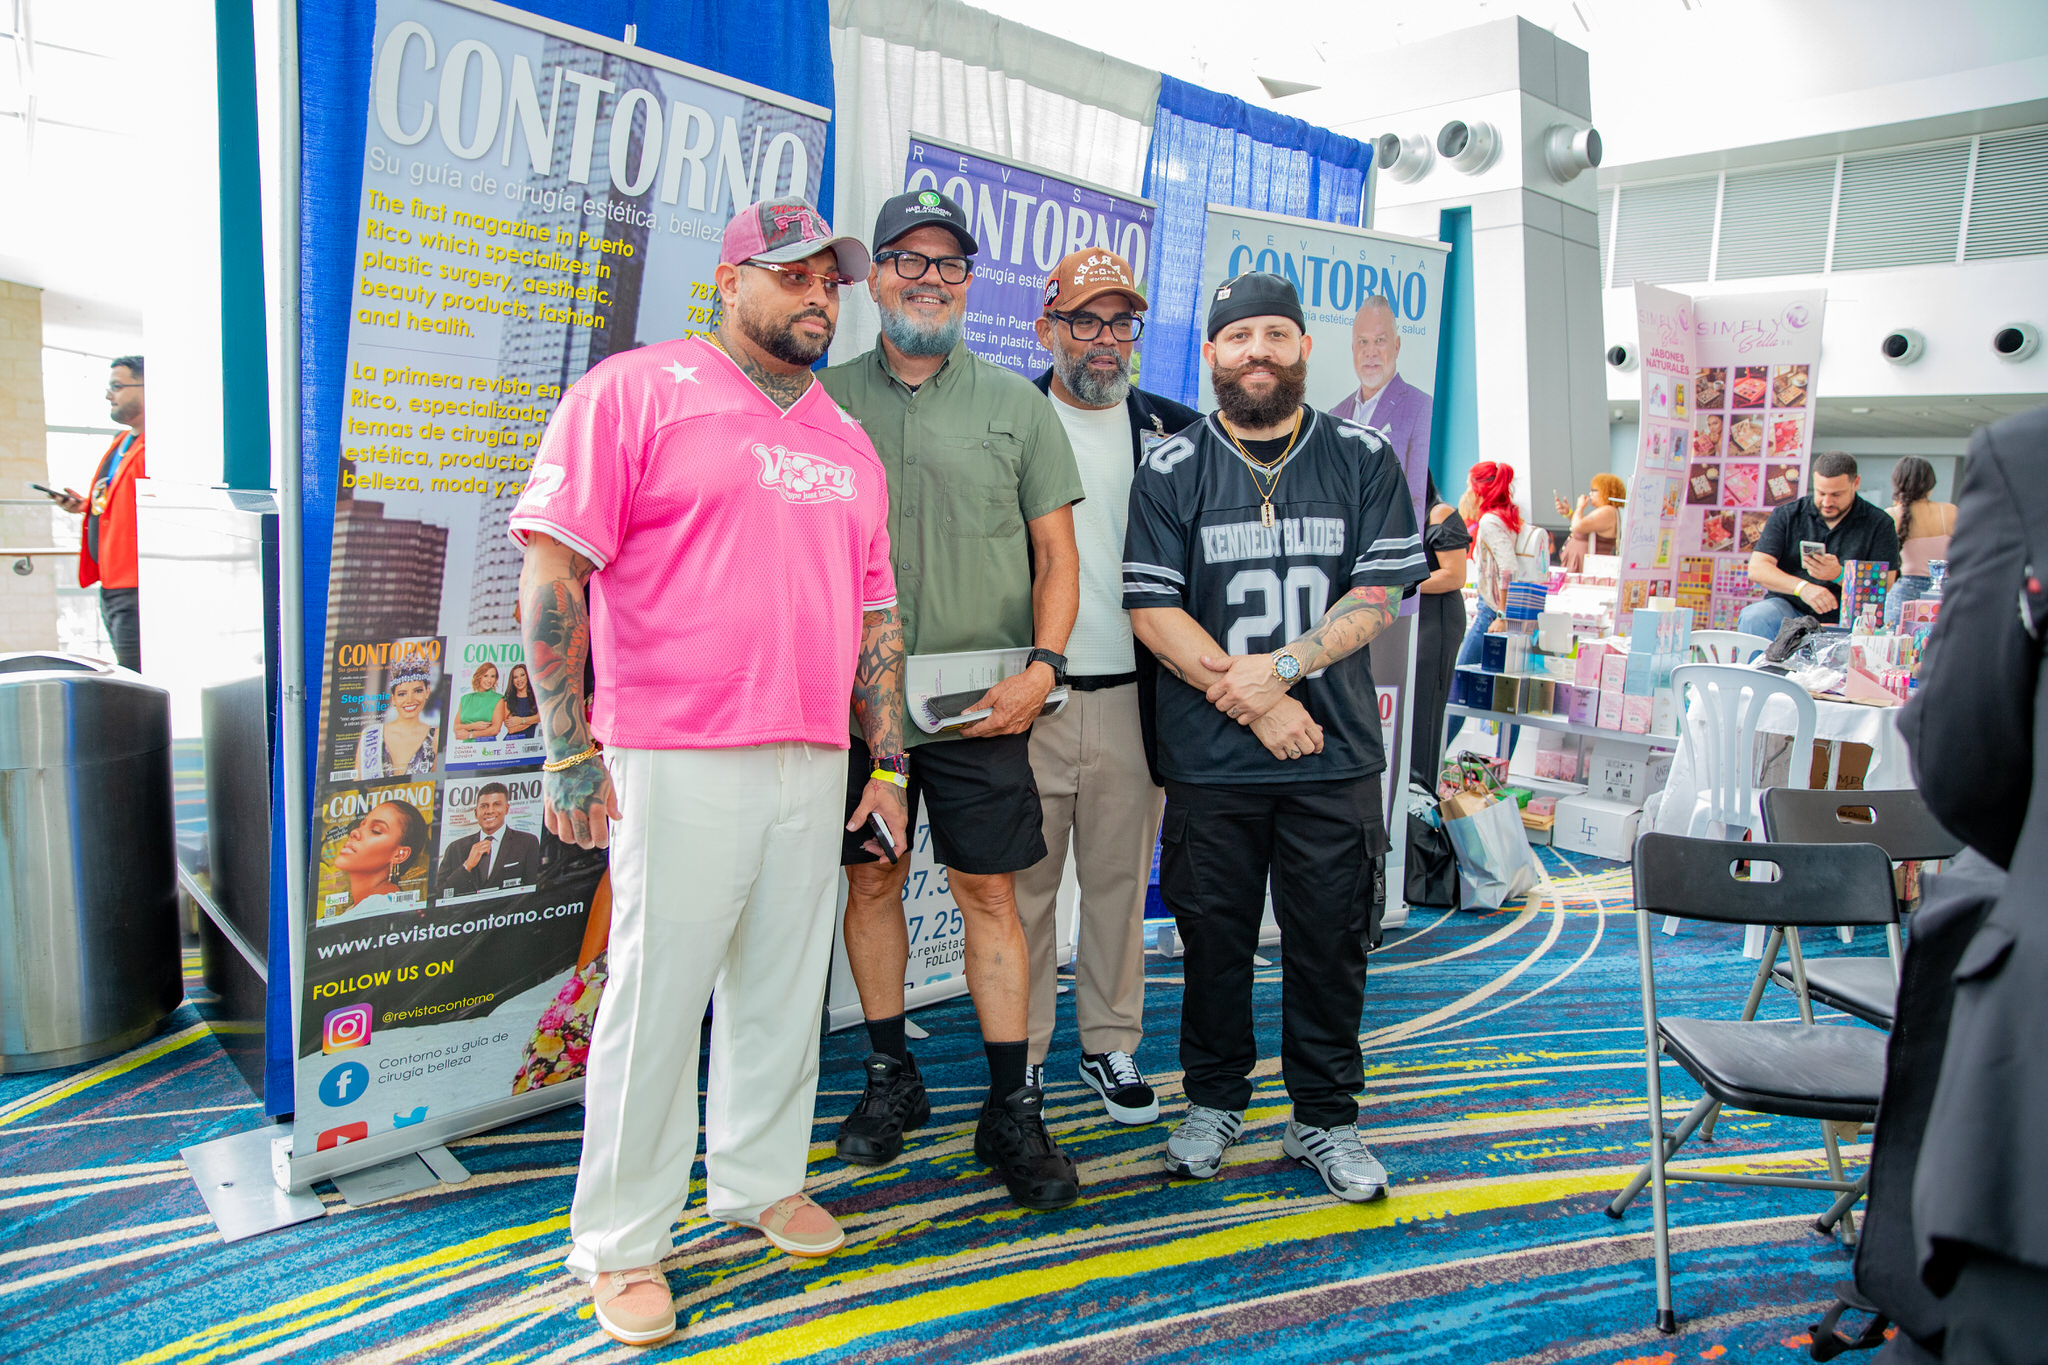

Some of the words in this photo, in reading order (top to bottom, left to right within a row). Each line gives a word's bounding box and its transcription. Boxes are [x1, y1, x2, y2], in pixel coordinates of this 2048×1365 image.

[376, 20, 808, 213] CONTORNO
[368, 147, 400, 175] Su
[409, 161, 463, 187] guía
[470, 171, 498, 195] de
[504, 178, 577, 213] cirugía
[582, 199, 662, 234] estética,
[912, 145, 1148, 222] REVISTA
[368, 189, 405, 213] The
[410, 197, 448, 223] first
[452, 210, 552, 243] magazine
[555, 226, 573, 247] in
[578, 231, 635, 258] Puerto
[905, 168, 1147, 290] ONTORNO
[365, 218, 412, 245] Rico
[418, 231, 480, 258] which
[484, 243, 591, 277] specializes
[594, 260, 611, 280] in
[1231, 229, 1426, 271] REVISTA
[362, 249, 433, 277] plastic
[439, 263, 518, 294] surgery,
[522, 278, 614, 308] aesthetic,
[975, 264, 1016, 286] cirugía
[1018, 271, 1049, 290] estét
[360, 276, 437, 308] beauty
[441, 292, 533, 321] products,
[538, 303, 606, 330] fashion
[357, 308, 400, 328] and
[406, 310, 475, 339] health.
[988, 331, 998, 345] in
[1000, 334, 1034, 350] plastic
[996, 313, 1006, 327] in
[1008, 315, 1037, 332] Puert
[1401, 325, 1427, 336] salud
[1645, 357, 1690, 376] NATURALES
[1650, 347, 1686, 364] JABONES
[352, 360, 376, 381] La
[382, 366, 463, 390] primera
[467, 376, 532, 398] revista
[537, 384, 563, 399] en
[350, 388, 402, 413] Rico,
[408, 397, 547, 425] especializada
[347, 415, 414, 439] temas
[418, 421, 446, 442] de
[450, 423, 518, 449] cirugía
[344, 443, 433, 468] estética,
[438, 449, 535, 472] productos
[341, 468, 424, 494] belleza,
[430, 474, 489, 494] moda
[493, 481, 507, 498] y
[1201, 520, 1281, 564] KENNEDY
[1282, 516, 1346, 557] BLADES
[1226, 565, 1331, 679] 20
[341, 691, 391, 705] Stephanie
[317, 900, 585, 960] www.revistacontorno.com
[312, 969, 392, 1001] FOLLOW
[396, 965, 420, 983] US
[424, 960, 455, 978] ON
[381, 992, 496, 1024] @revistacontorno
[379, 1049, 442, 1070] Contorno
[445, 1045, 459, 1055] su
[492, 1032, 509, 1043] de
[427, 1054, 472, 1073] belleza
